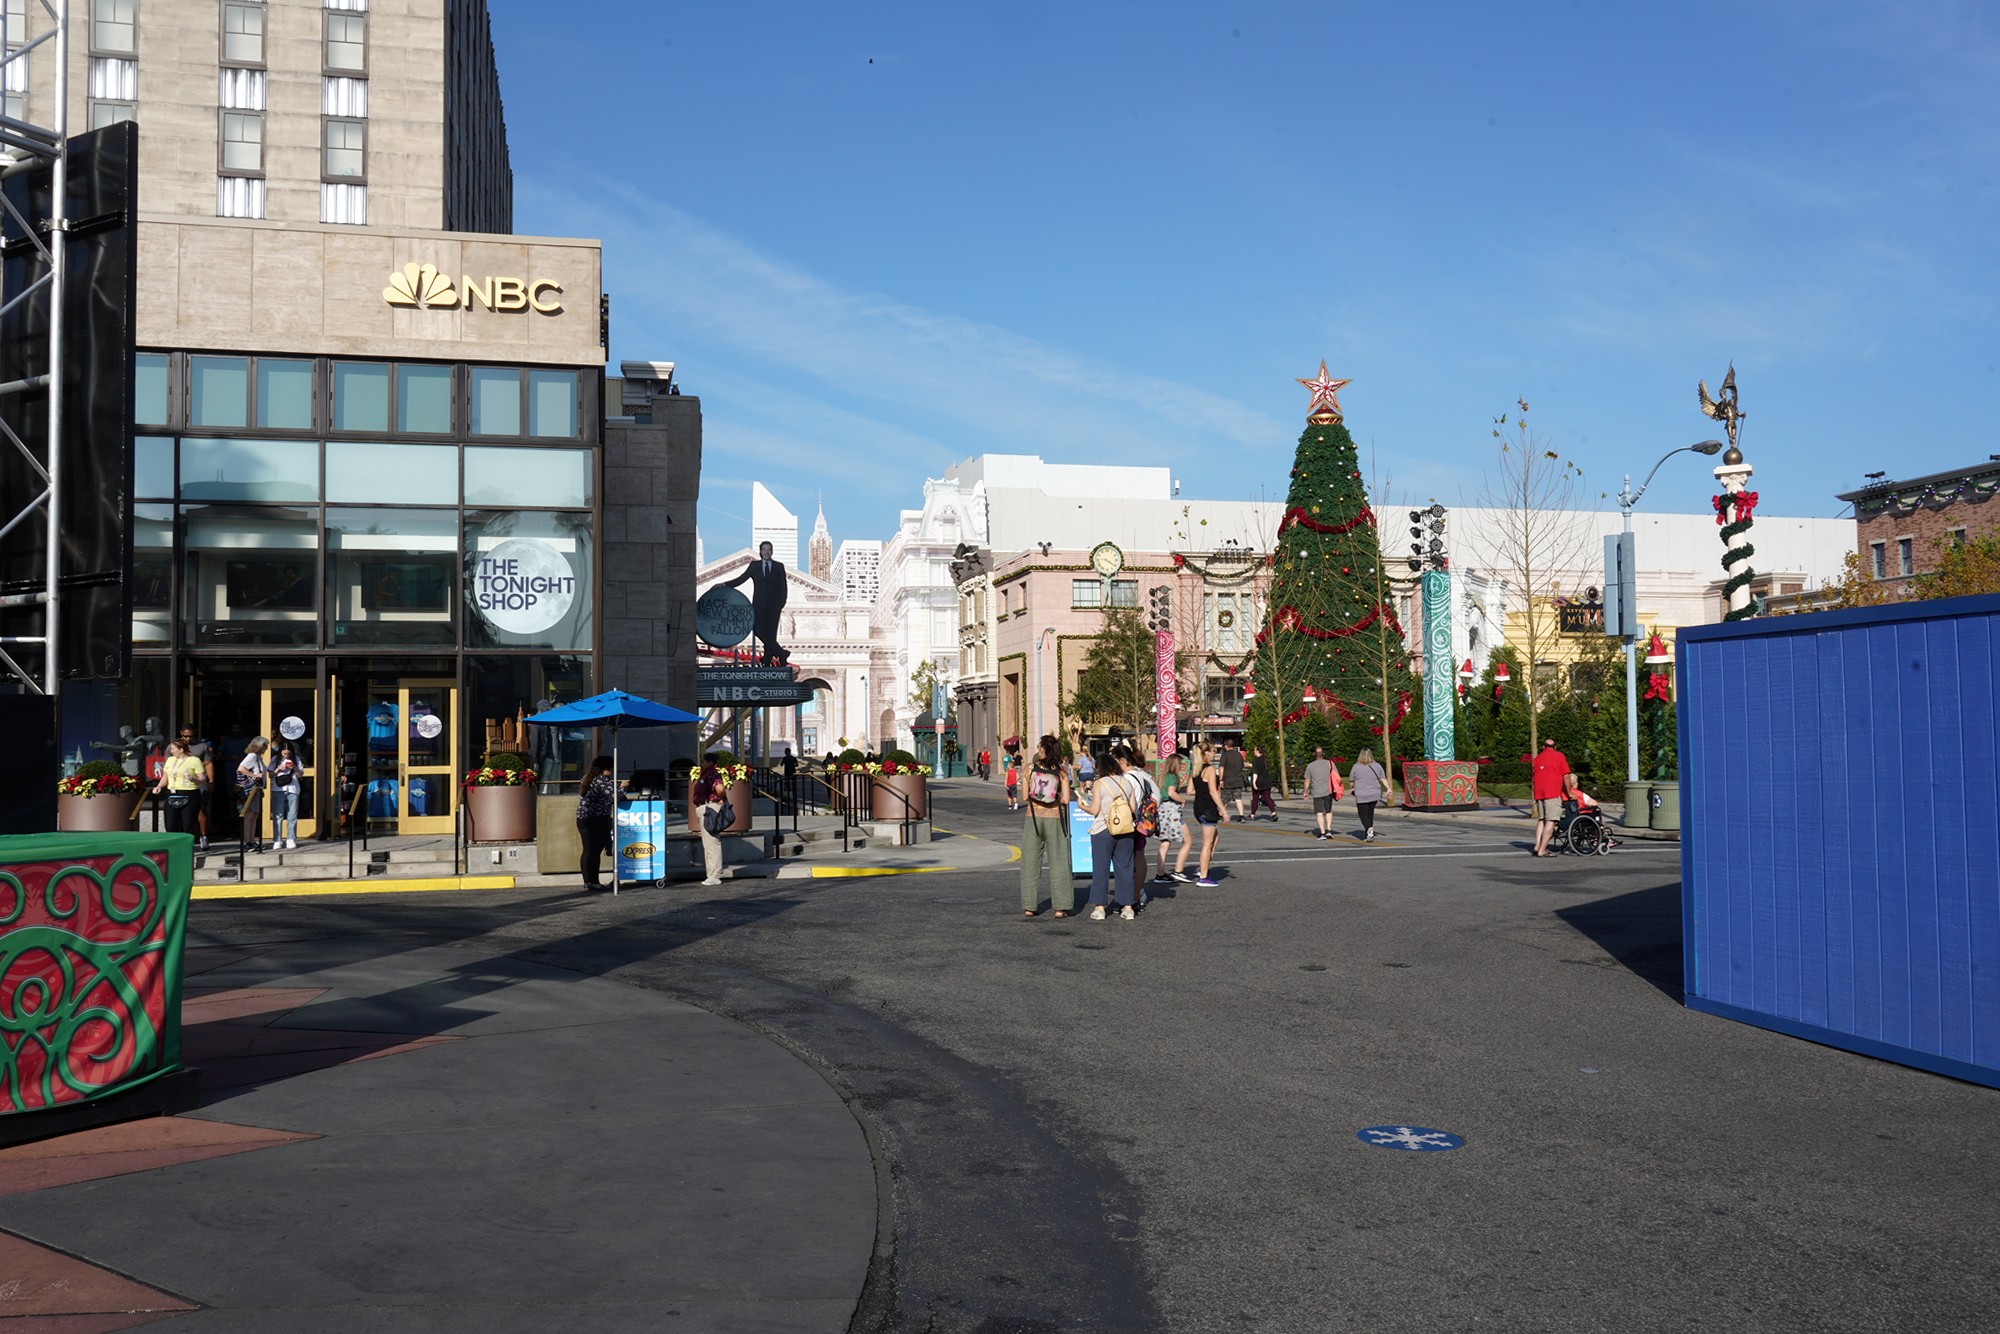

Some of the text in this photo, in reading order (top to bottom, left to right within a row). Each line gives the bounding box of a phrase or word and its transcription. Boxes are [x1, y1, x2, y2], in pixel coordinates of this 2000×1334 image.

[462, 275, 562, 313] NBC
[481, 558, 518, 576] THE
[479, 575, 575, 594] TONIGHT
[479, 594, 538, 610] SHOP
[698, 598, 728, 608] RACE
[698, 608, 753, 618] NEW YORK
[719, 617, 752, 627] JIMMY
[710, 626, 750, 636] FALLON
[703, 671, 787, 680] THE TONIGHT SHOW
[713, 686, 761, 701] NBC
[617, 812, 662, 826] SKIP
[625, 846, 654, 857] EXPRESS
